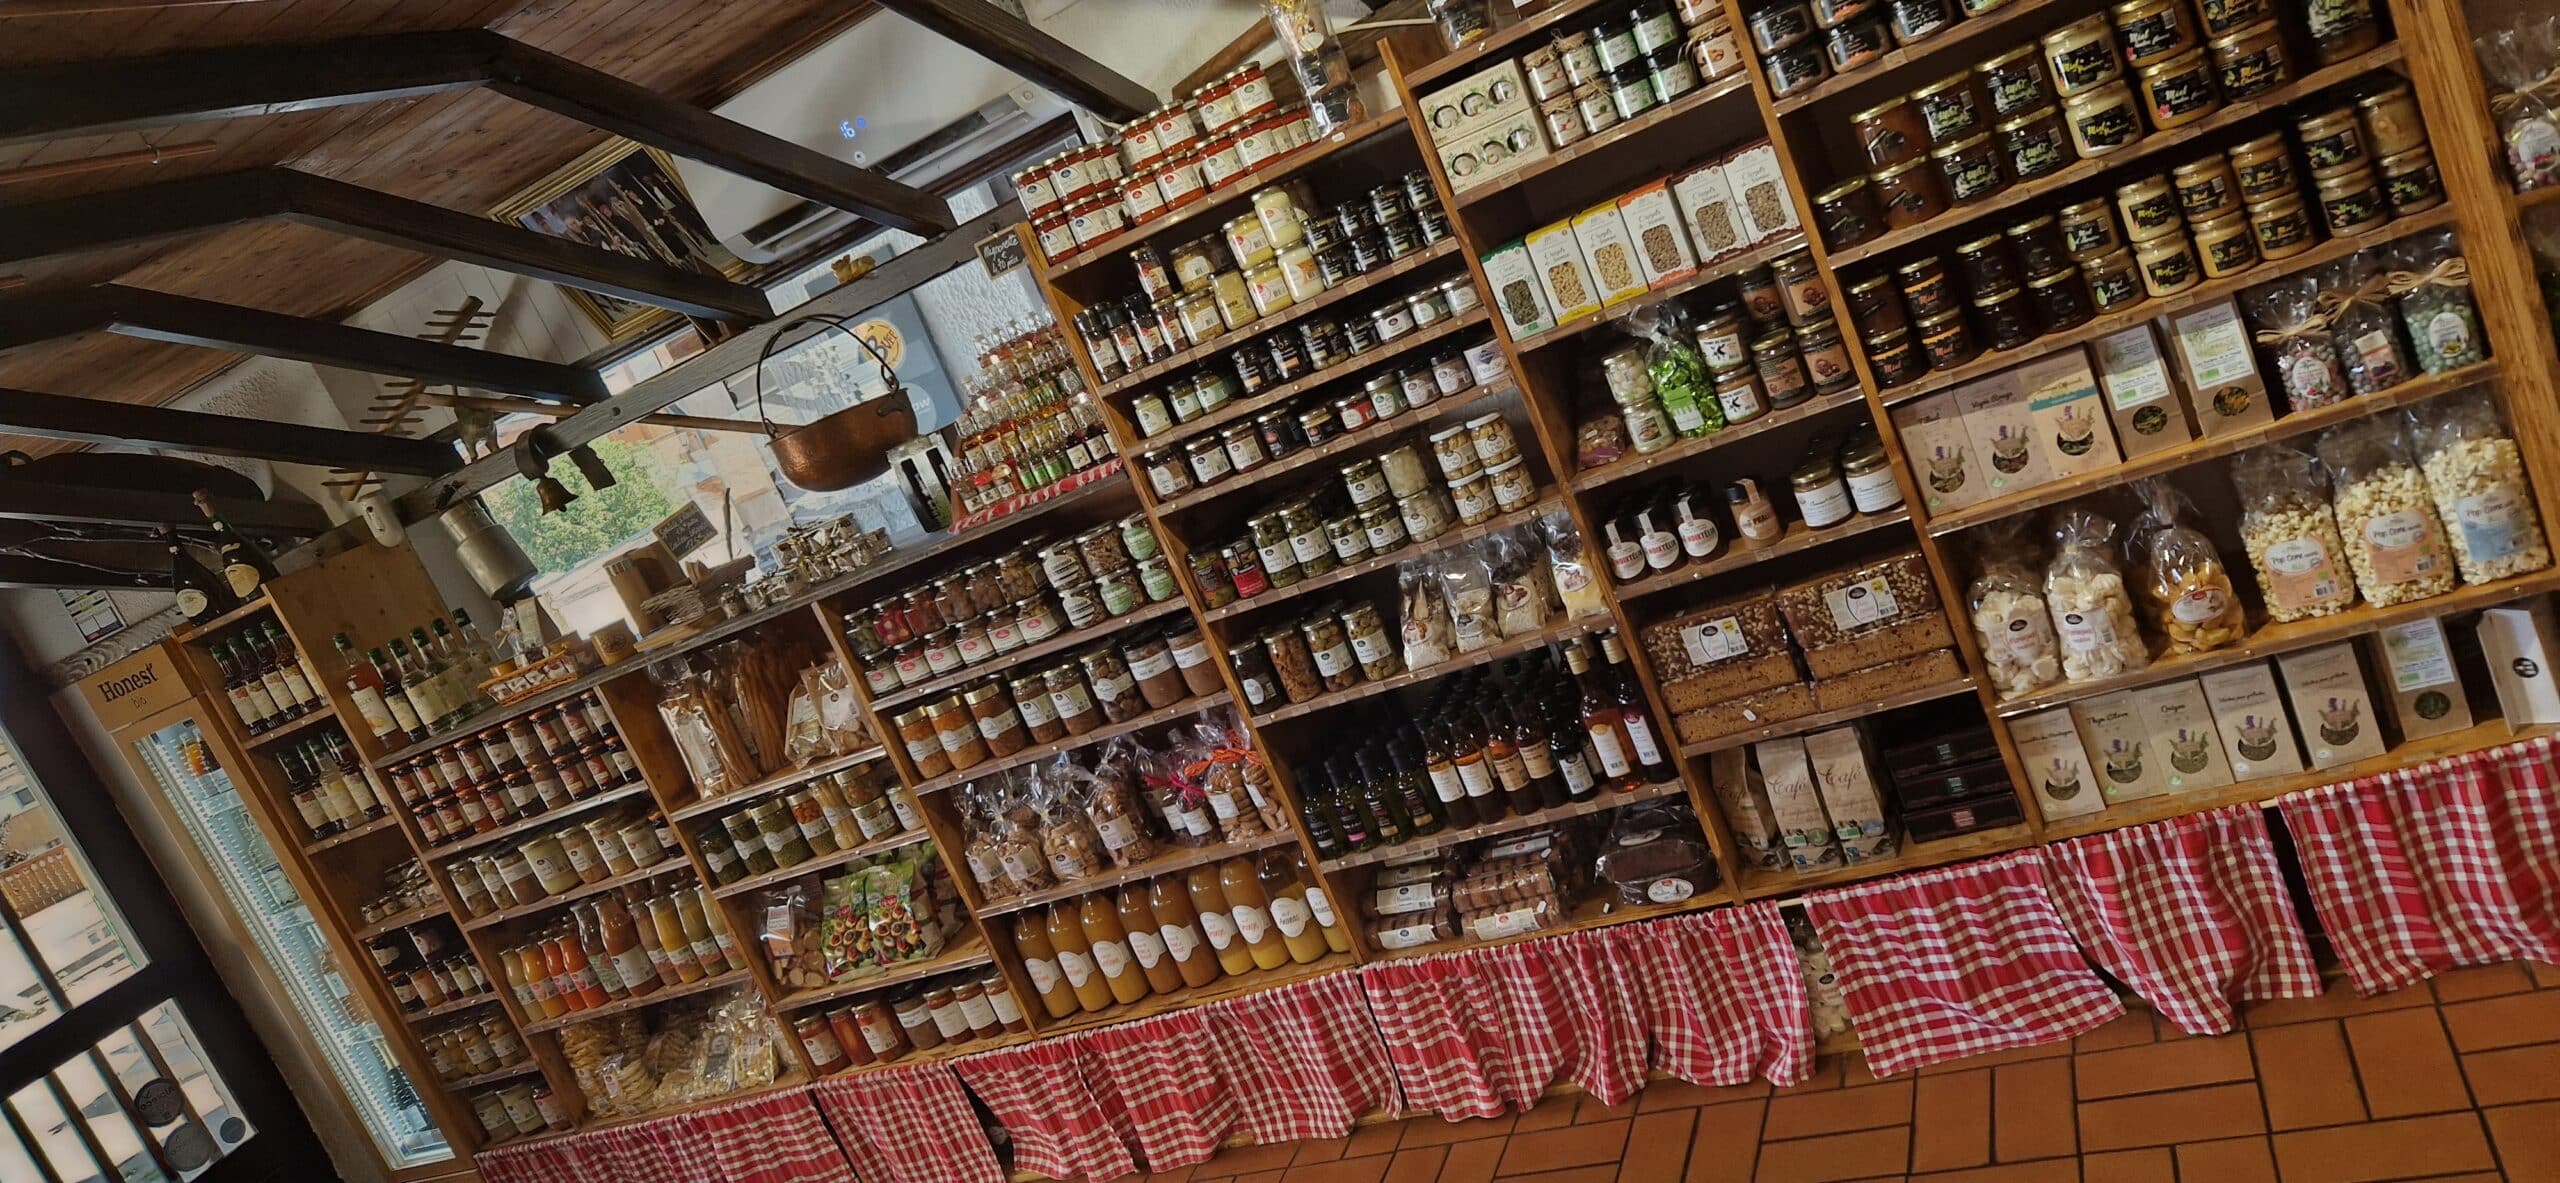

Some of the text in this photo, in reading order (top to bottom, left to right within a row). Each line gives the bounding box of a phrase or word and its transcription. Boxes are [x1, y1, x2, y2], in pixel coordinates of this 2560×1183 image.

[838, 120, 855, 140] 16
[98, 663, 158, 703] Honest
[1767, 775, 1806, 800] Café
[1818, 766, 1861, 790] Café
